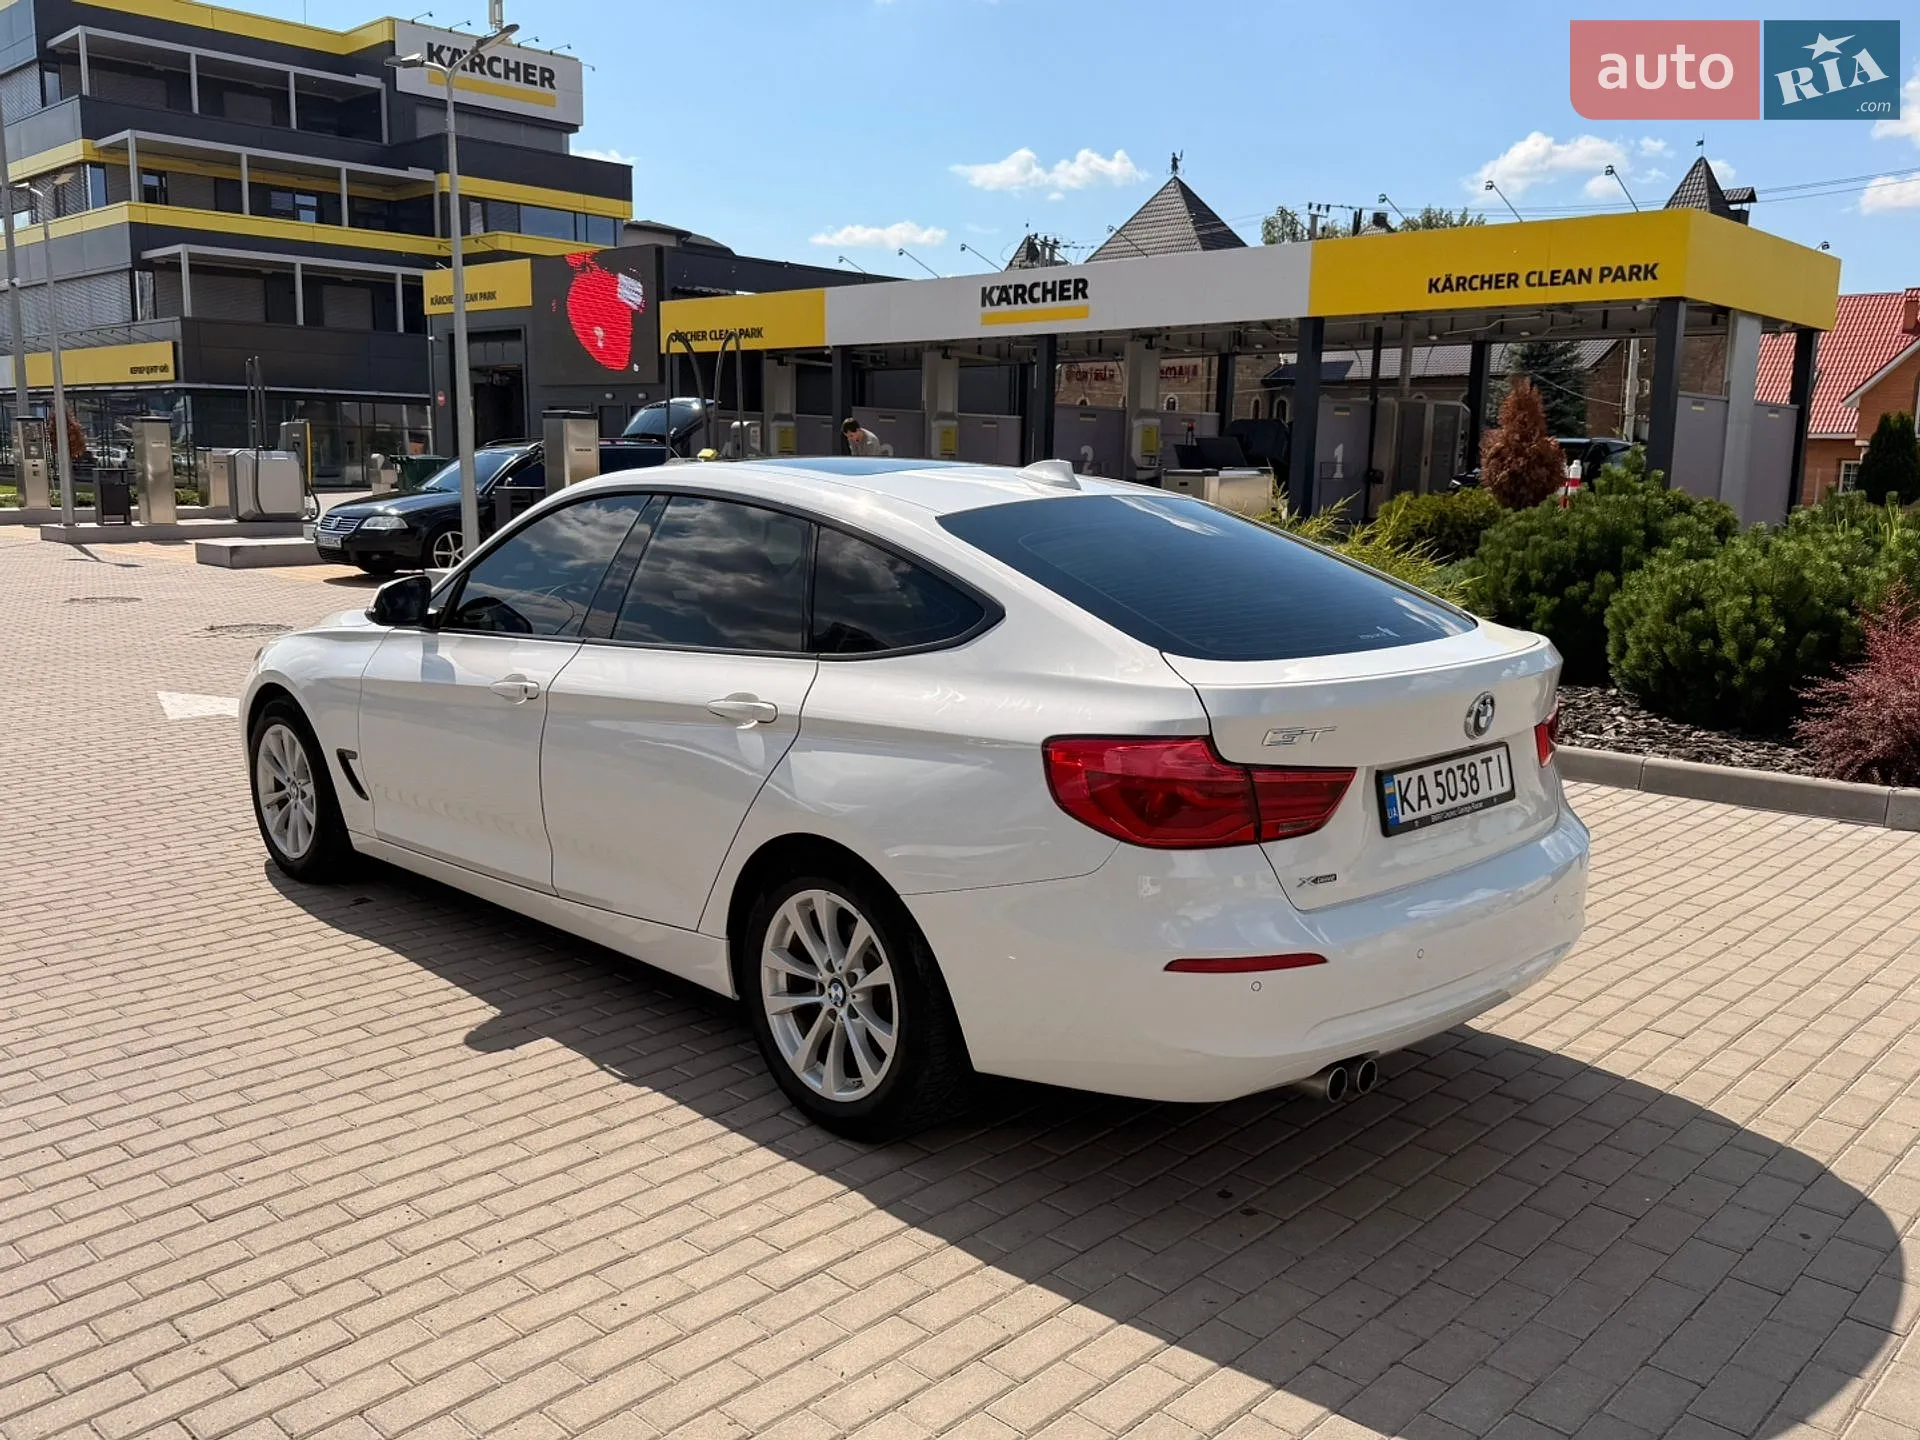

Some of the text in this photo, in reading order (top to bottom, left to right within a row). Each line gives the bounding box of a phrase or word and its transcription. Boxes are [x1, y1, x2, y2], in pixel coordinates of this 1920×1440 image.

[426, 42, 556, 90] KÄRCHER
[981, 278, 1089, 307] KÄRCHER
[1428, 262, 1659, 294] KÄRCHER CLEAN PARK
[738, 326, 764, 339] PARK
[1333, 443, 1344, 478] 1
[1262, 726, 1338, 747] GT
[1397, 774, 1432, 815] KA
[1434, 762, 1480, 805] 5038
